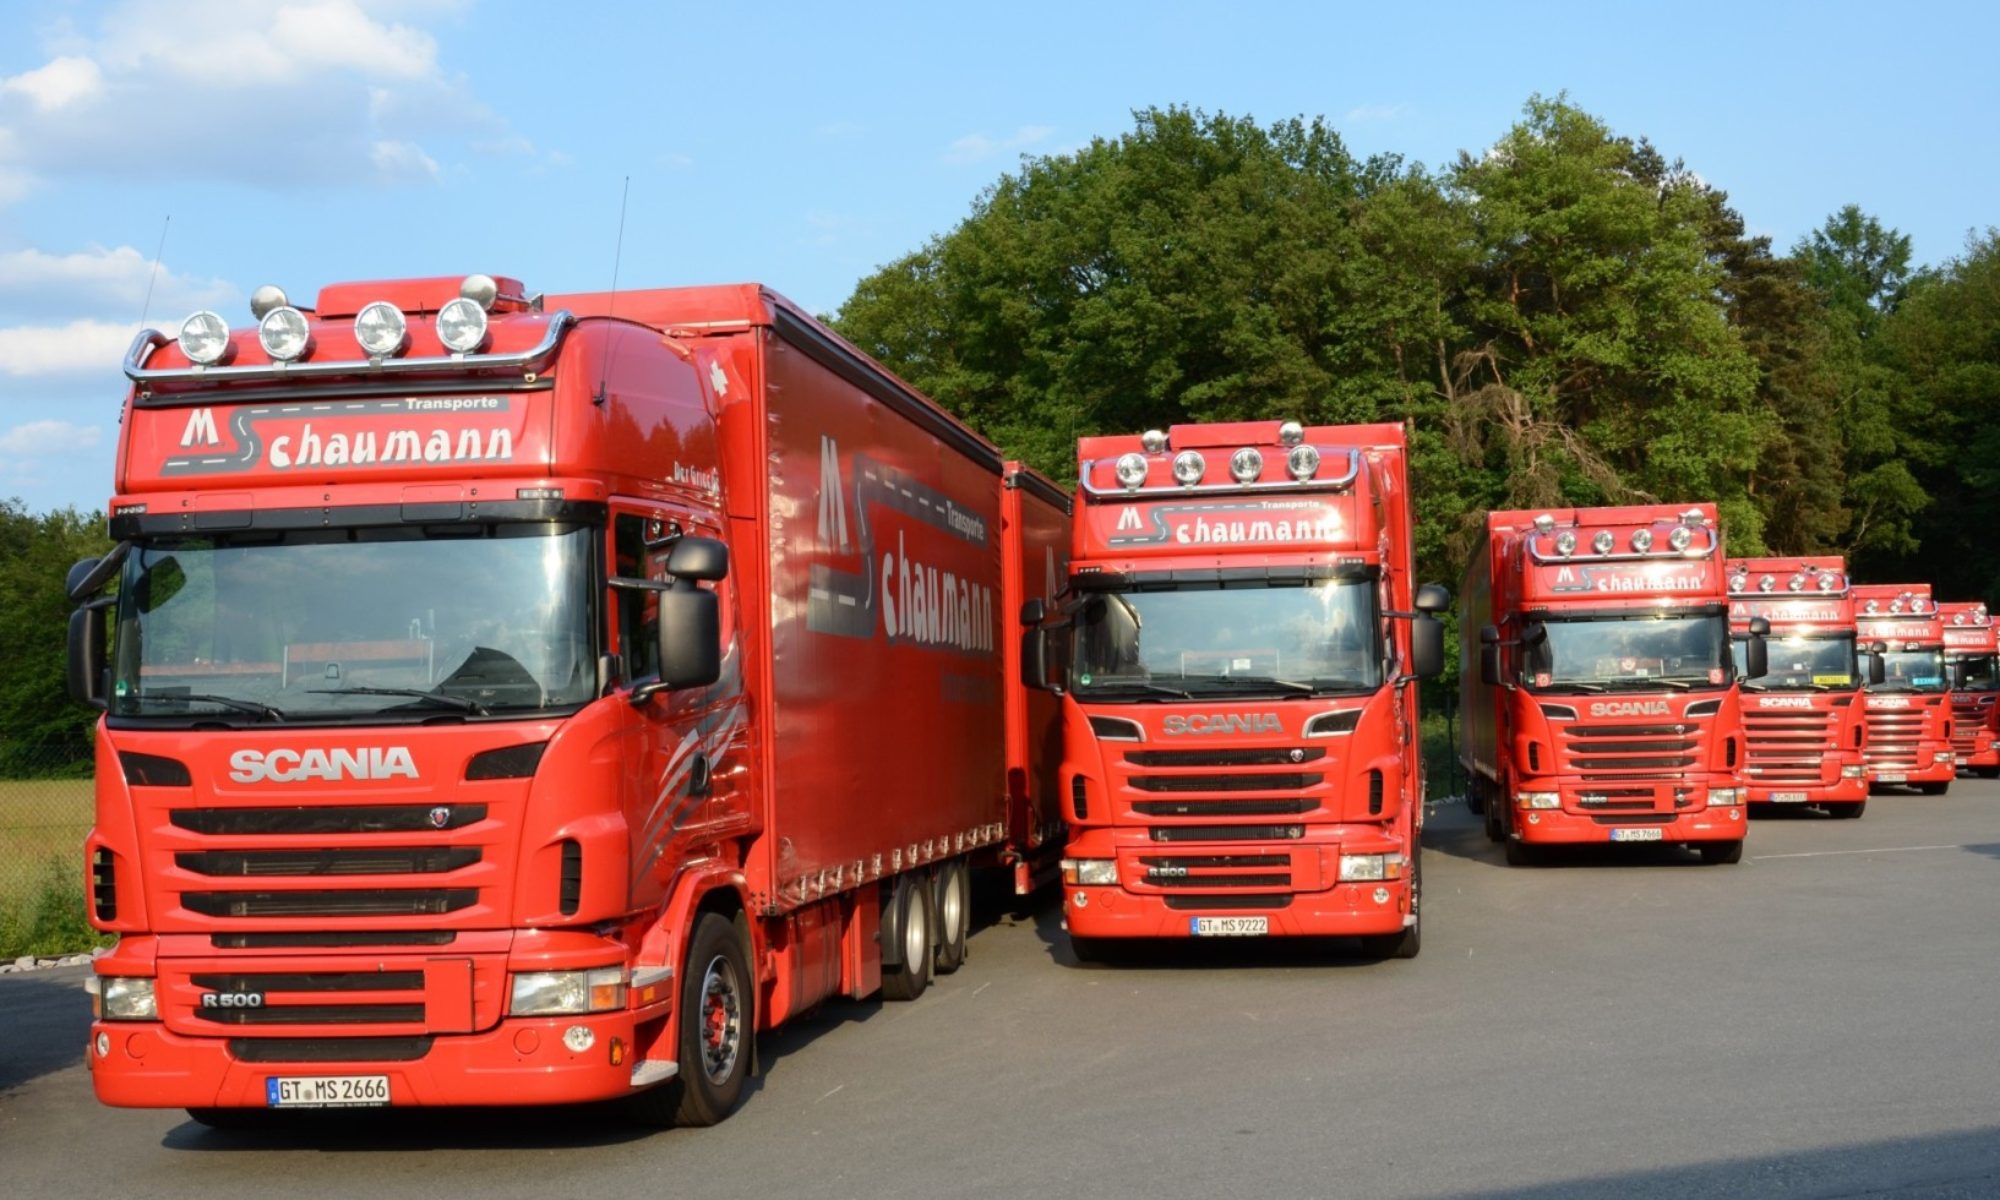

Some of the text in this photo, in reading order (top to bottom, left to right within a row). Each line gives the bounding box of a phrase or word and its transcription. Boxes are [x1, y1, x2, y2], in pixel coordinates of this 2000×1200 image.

[405, 397, 498, 411] Transporte
[180, 407, 219, 447] M
[818, 434, 848, 549] M
[1260, 501, 1319, 511] Transporte
[945, 500, 984, 541] Transporte
[1117, 507, 1143, 530] M
[1557, 566, 1574, 582] M
[1590, 701, 1671, 716] SCANIA
[1759, 697, 1813, 708] SCANIA
[1163, 713, 1283, 735] SCANIA
[229, 747, 420, 782] SCANIA
[1199, 919, 1265, 932] GT MS 9222
[203, 992, 261, 1007] R 500
[280, 1079, 386, 1099] GT MS 2666
